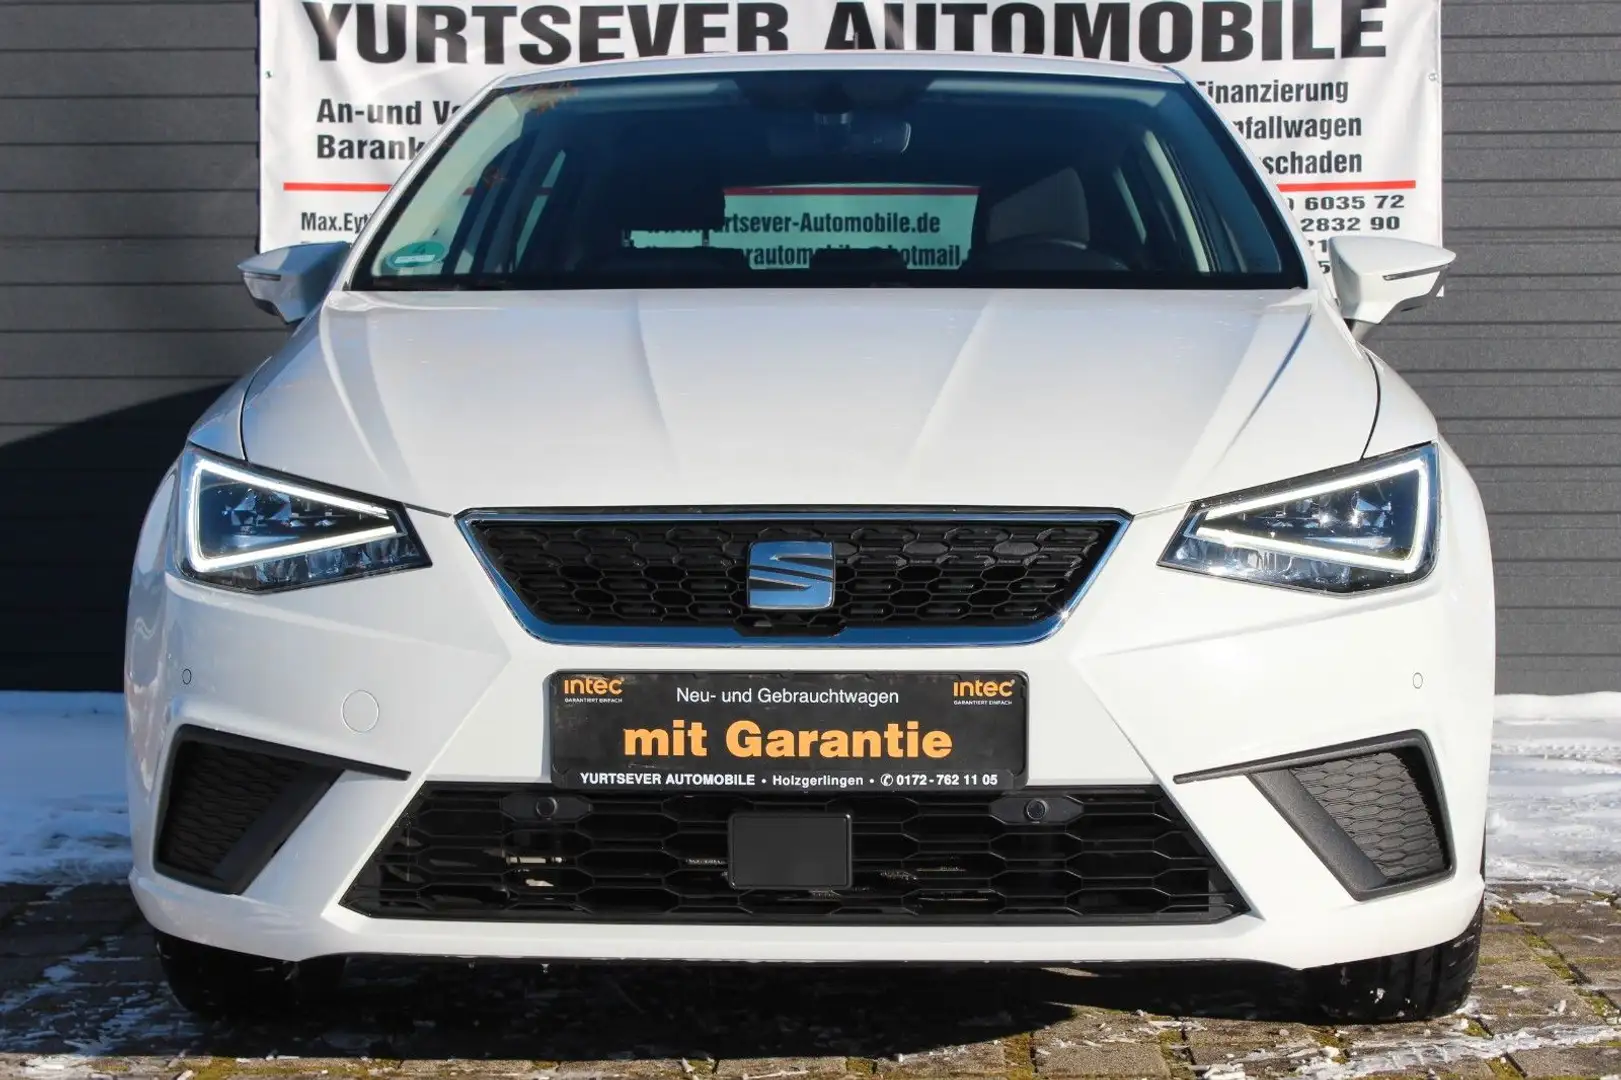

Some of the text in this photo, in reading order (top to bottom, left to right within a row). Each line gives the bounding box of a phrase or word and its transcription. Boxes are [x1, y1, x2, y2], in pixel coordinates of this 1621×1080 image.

[302, 0, 1386, 65] YURTSEVER AUTOMOBILE
[316, 98, 422, 126] An-und
[1259, 150, 1362, 175] schaden
[1305, 196, 1366, 211] 6035
[1374, 195, 1405, 209] 72
[300, 211, 372, 234] Max.Eyt
[714, 211, 938, 233] rtsever-Automobile.de
[1300, 215, 1400, 232] 2832 90
[564, 676, 624, 695] intec
[953, 680, 1014, 697] intec
[676, 687, 900, 708] Neu- und Gebrauchtwagen
[624, 719, 953, 758] mit Garantie
[580, 773, 663, 786] YURTSEVER
[665, 773, 756, 786] AUTOMOBILE
[772, 774, 864, 789] Holzgerlingen
[963, 773, 979, 786] 11
[982, 772, 998, 786] 05
